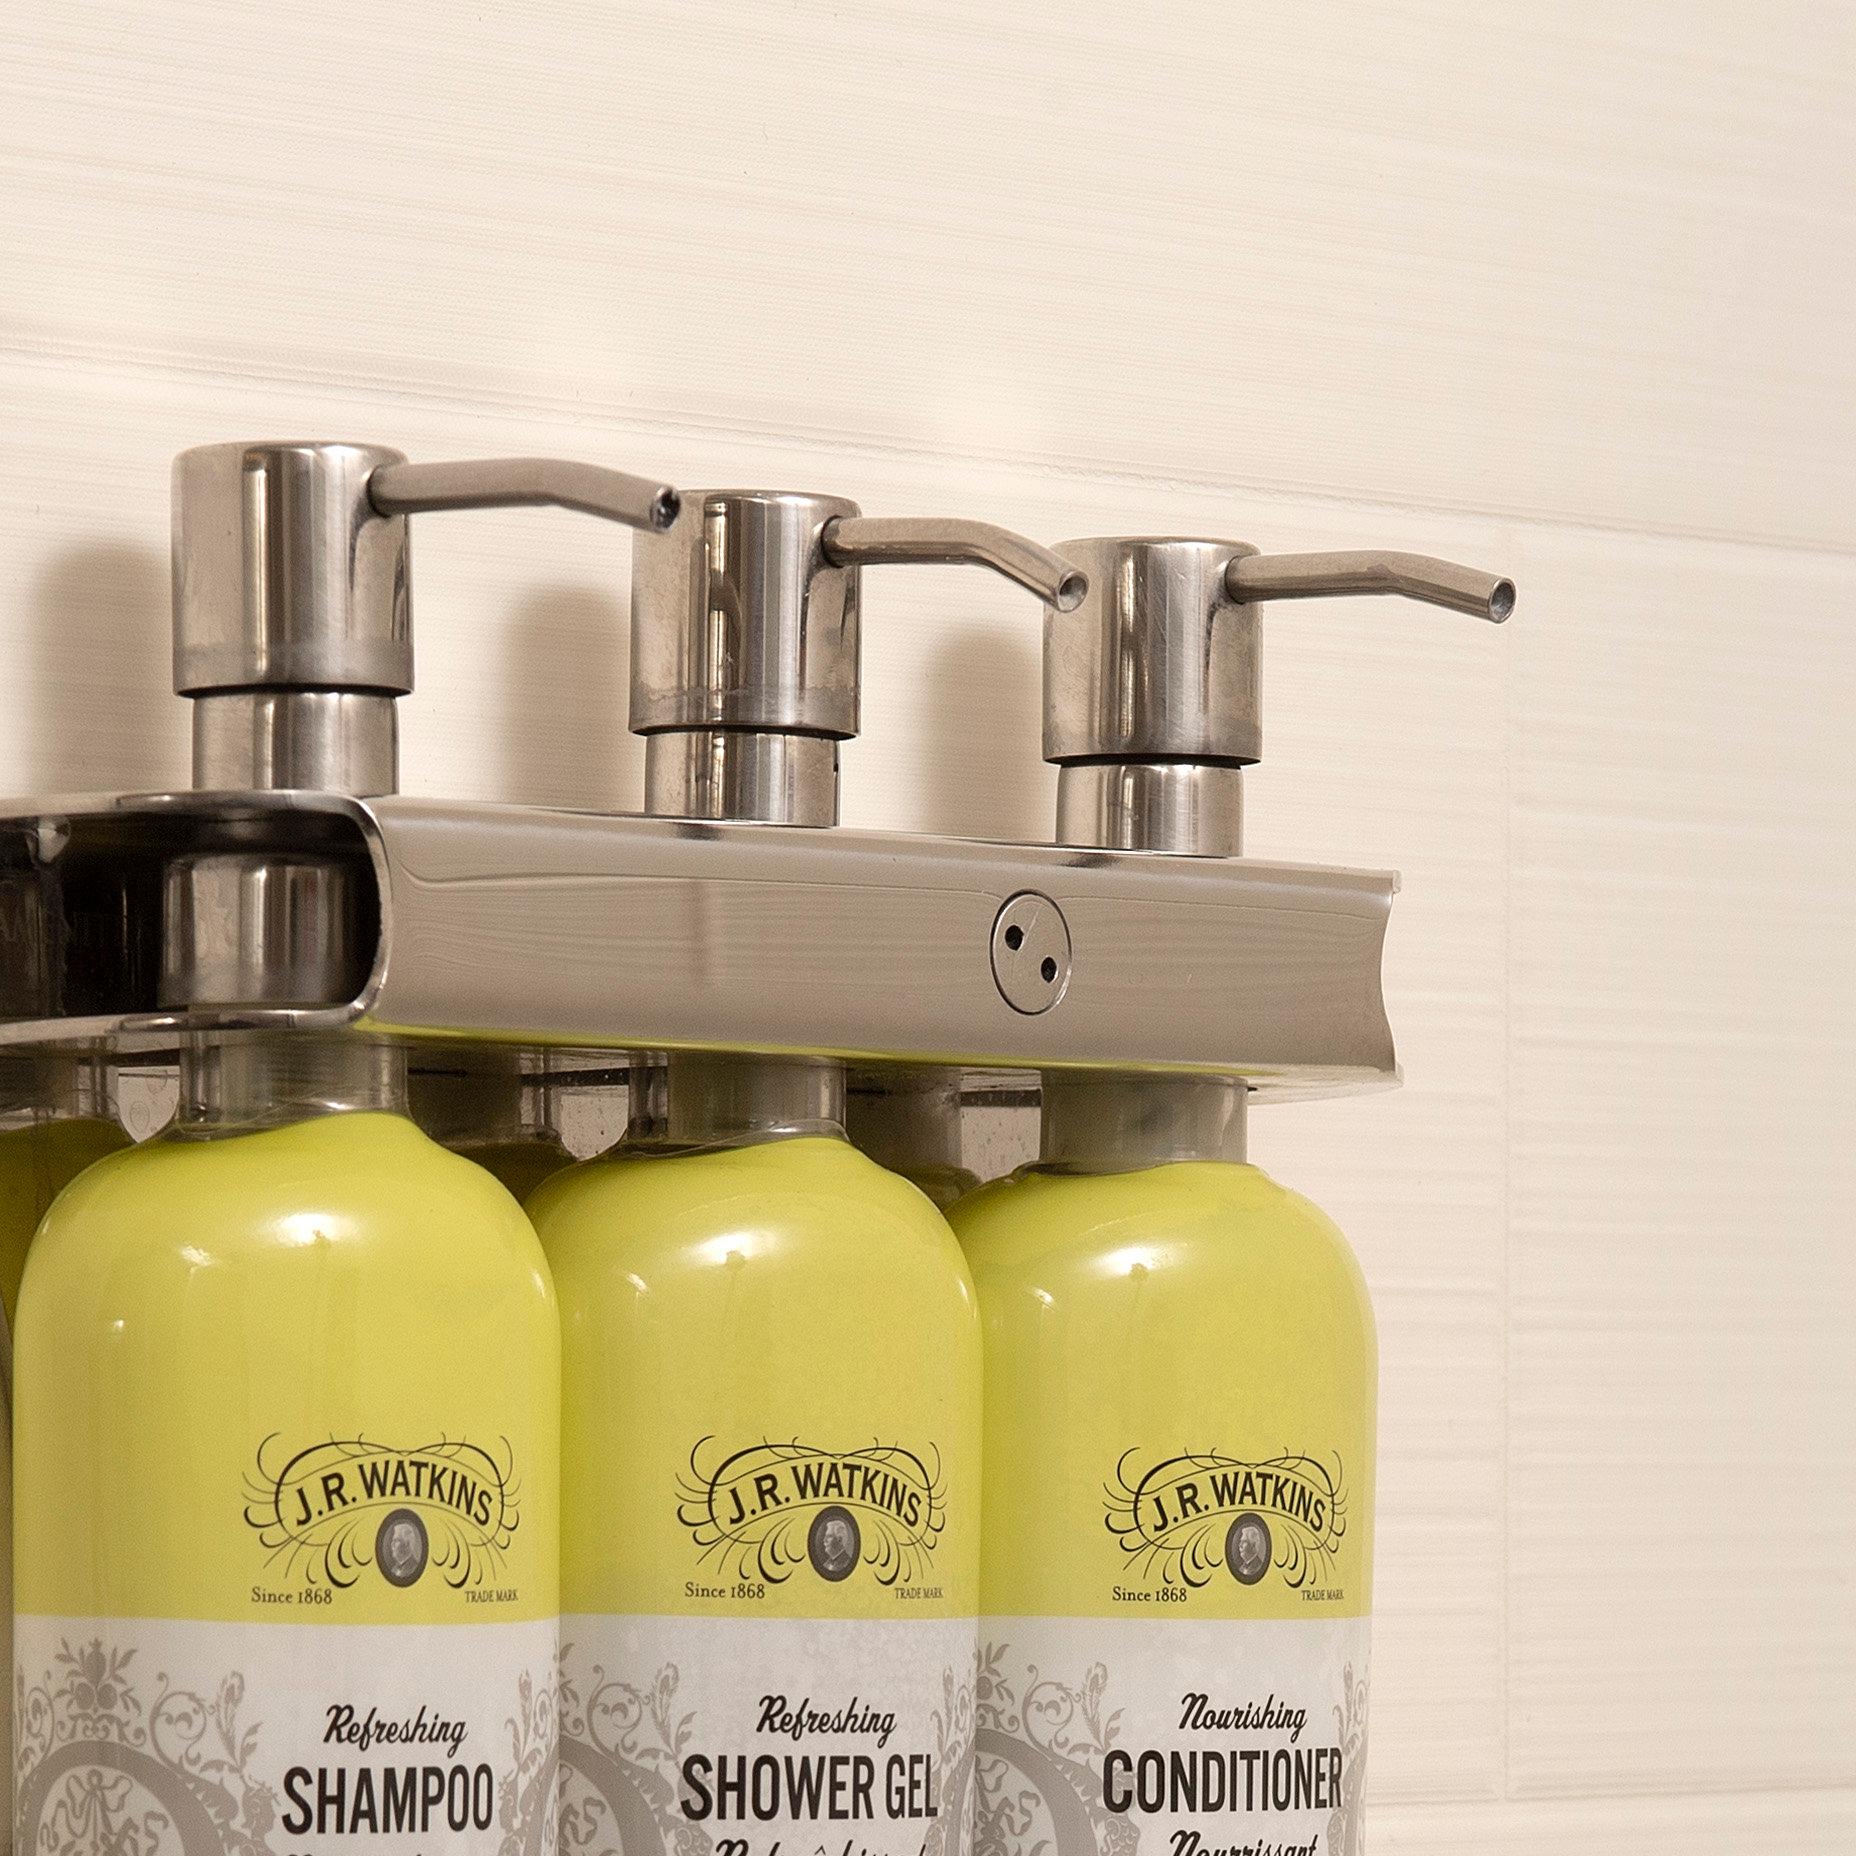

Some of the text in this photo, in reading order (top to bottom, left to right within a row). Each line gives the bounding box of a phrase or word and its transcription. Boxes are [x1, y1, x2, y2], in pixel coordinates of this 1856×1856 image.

[295, 1459, 493, 1527] J.R. WATKINS
[729, 1462, 922, 1527] J.R. WATKINS
[1153, 1471, 1326, 1532] J.R. WATKINS
[252, 1587, 332, 1605] Since 1868
[465, 1589, 518, 1604] TRADE MARK
[685, 1582, 765, 1599] Since 1868
[895, 1587, 921, 1600] TRADE
[1112, 1586, 1187, 1602] Since 1868
[1301, 1589, 1325, 1601] TRADE
[323, 1704, 467, 1758] Refreshing
[756, 1695, 897, 1749] Refreshing
[1178, 1692, 1307, 1744] Nourishing
[282, 1763, 493, 1834] SHAMPOO
[680, 1754, 938, 1821] SHOWER GEL
[1103, 1748, 1343, 1814] CONDITIONER
